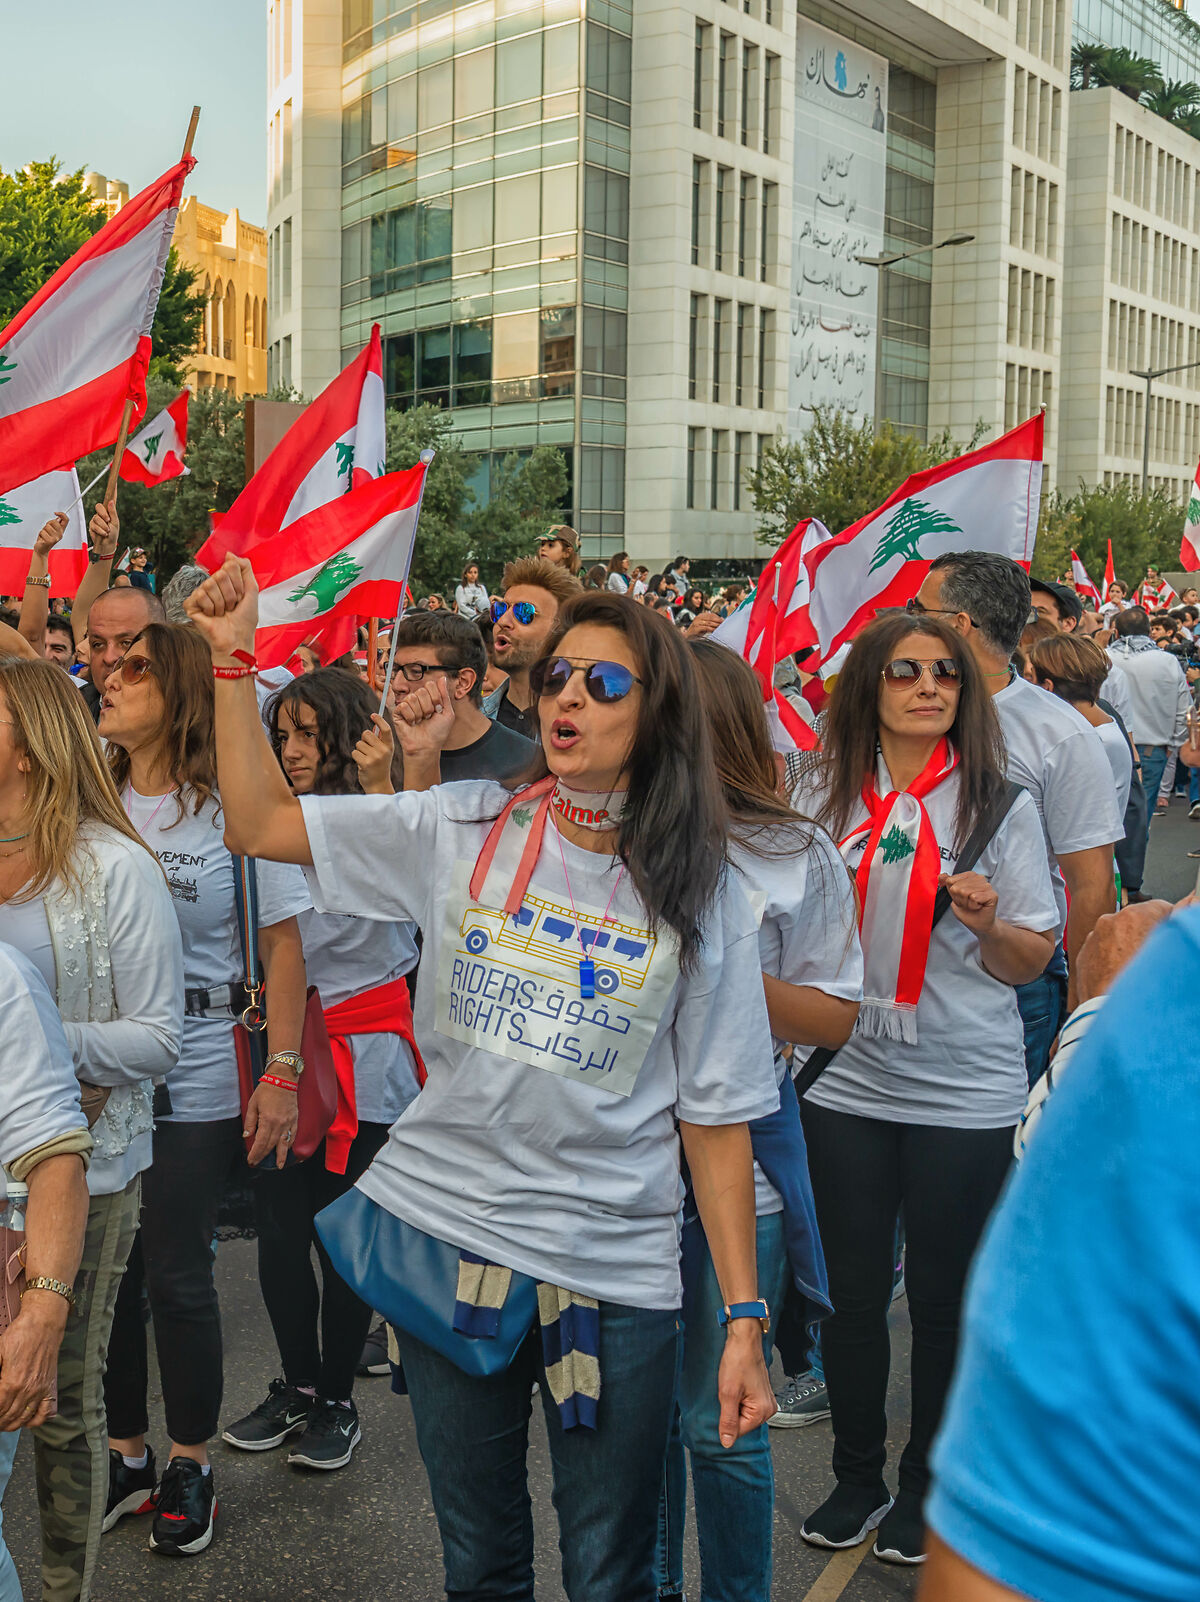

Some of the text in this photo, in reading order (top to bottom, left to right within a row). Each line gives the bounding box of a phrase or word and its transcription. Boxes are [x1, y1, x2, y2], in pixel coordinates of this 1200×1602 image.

[155, 850, 208, 868] VEMENT
[451, 958, 545, 1011] RIDERS'
[448, 991, 527, 1043] RIGHTS
[530, 988, 632, 1036] حقوق
[518, 1031, 619, 1073] الركاب
